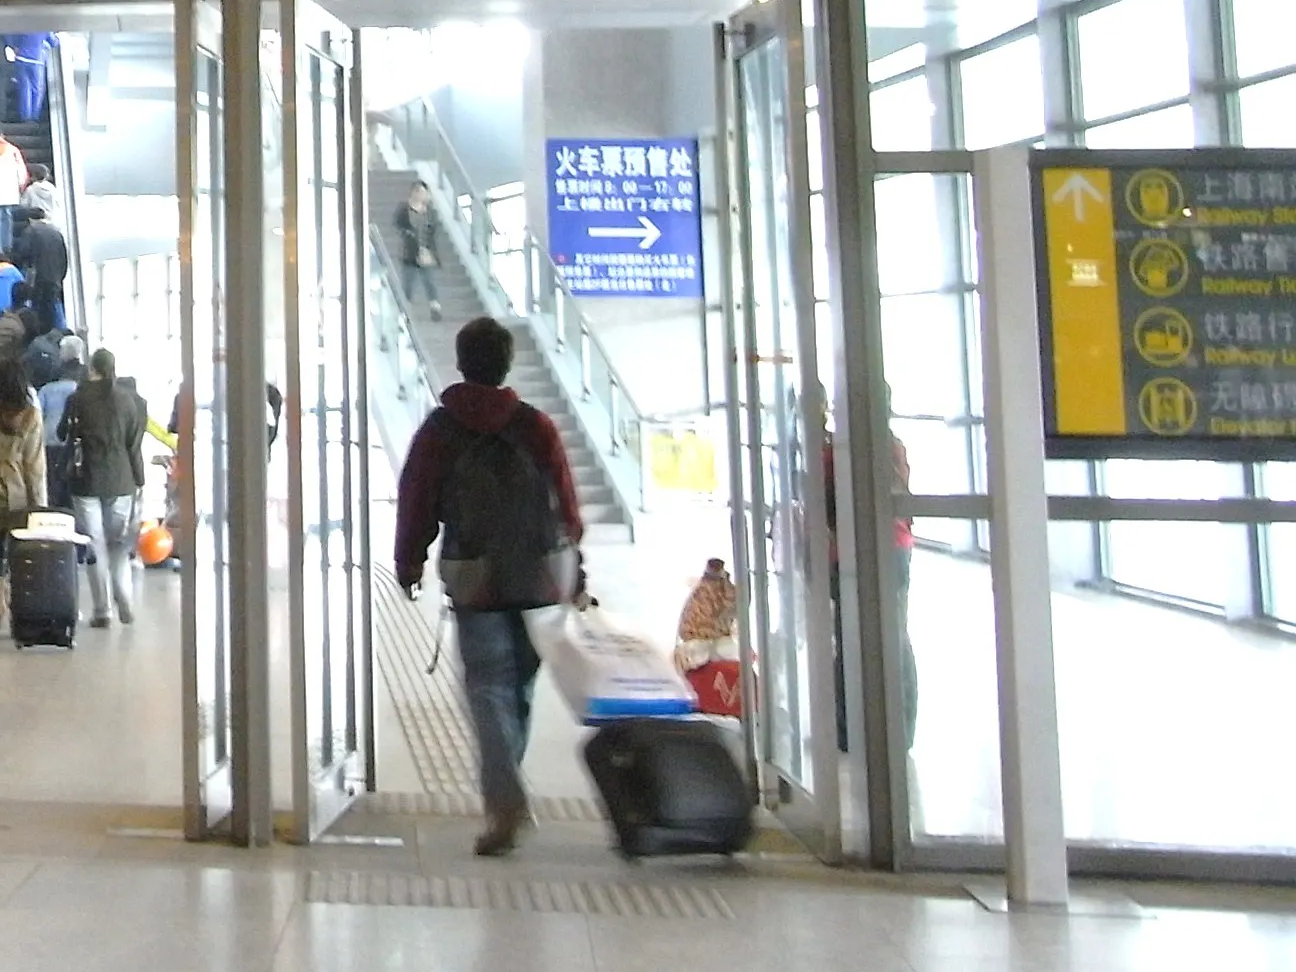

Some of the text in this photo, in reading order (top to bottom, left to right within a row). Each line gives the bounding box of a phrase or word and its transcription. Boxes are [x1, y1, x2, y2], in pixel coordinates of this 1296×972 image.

[555, 145, 693, 177] 火车票预售处
